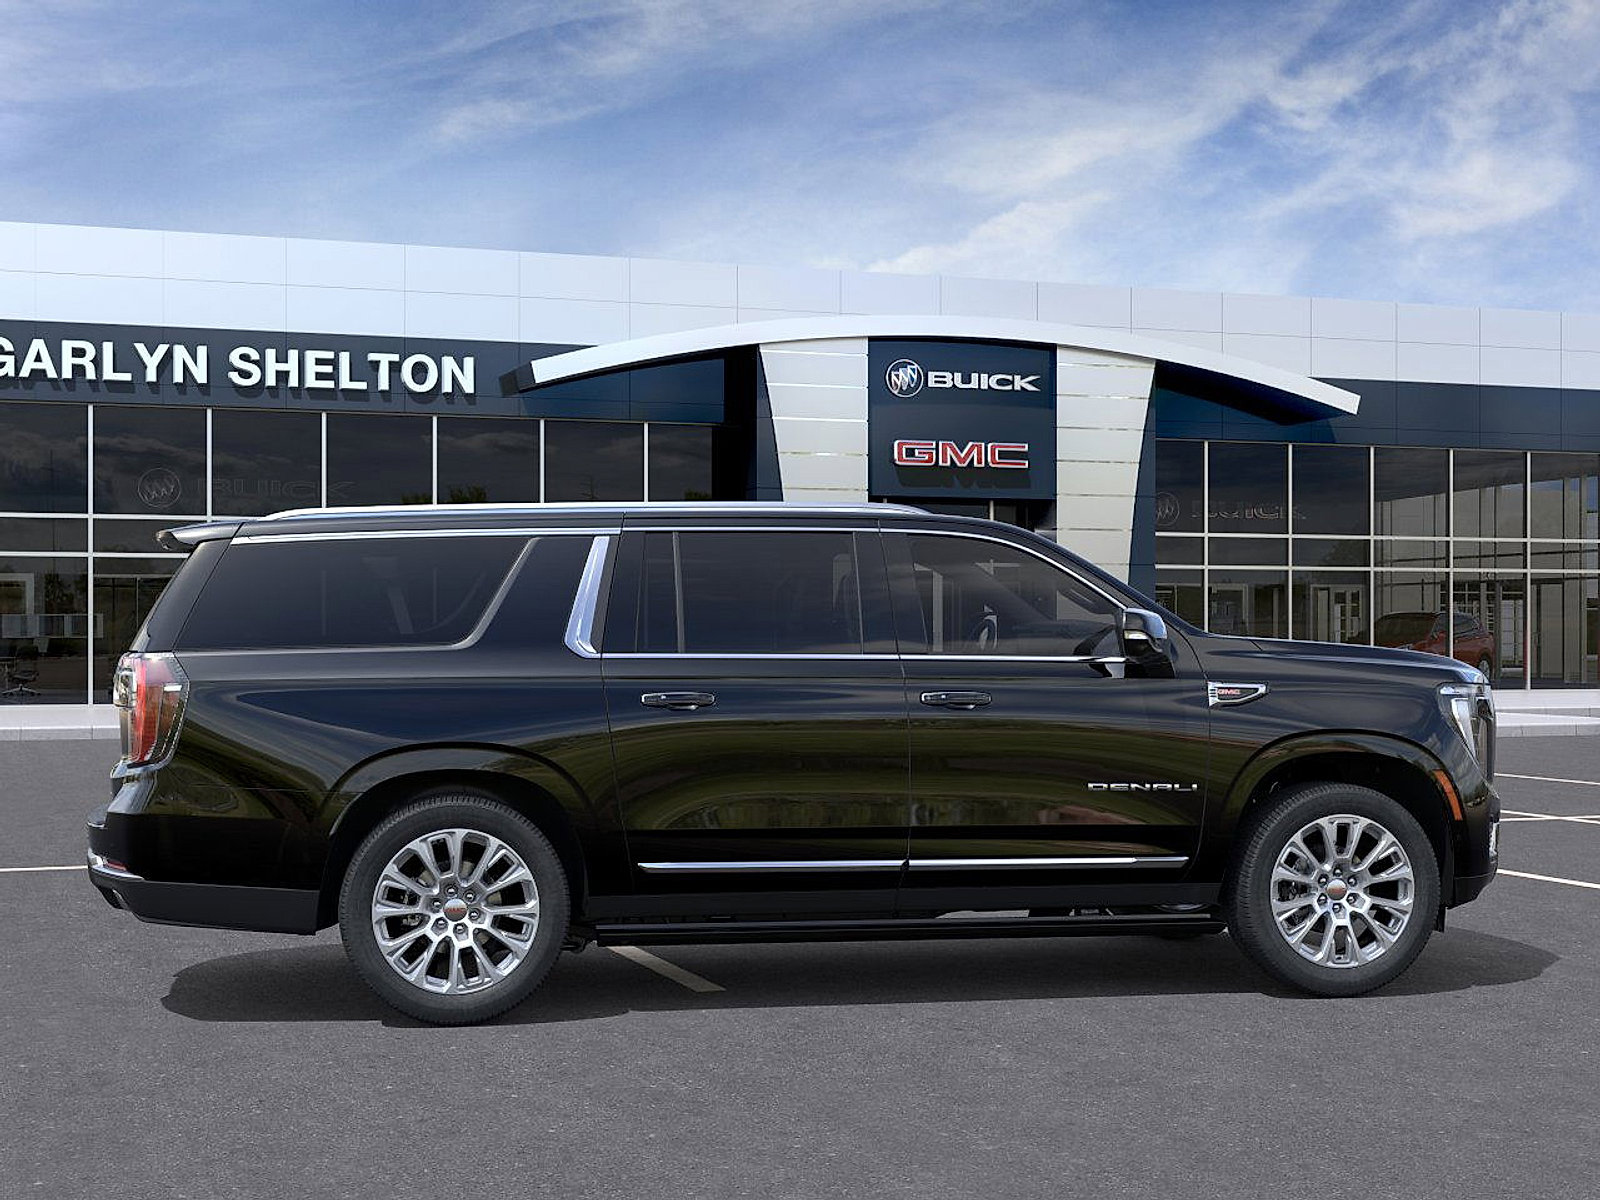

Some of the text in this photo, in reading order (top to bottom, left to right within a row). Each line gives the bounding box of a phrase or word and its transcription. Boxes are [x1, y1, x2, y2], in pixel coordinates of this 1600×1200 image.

[228, 346, 475, 394] SHELTON
[927, 371, 1041, 391] BUICK
[893, 440, 1029, 468] GMC
[1218, 688, 1241, 696] GMC
[1087, 783, 1198, 791] DENALI
